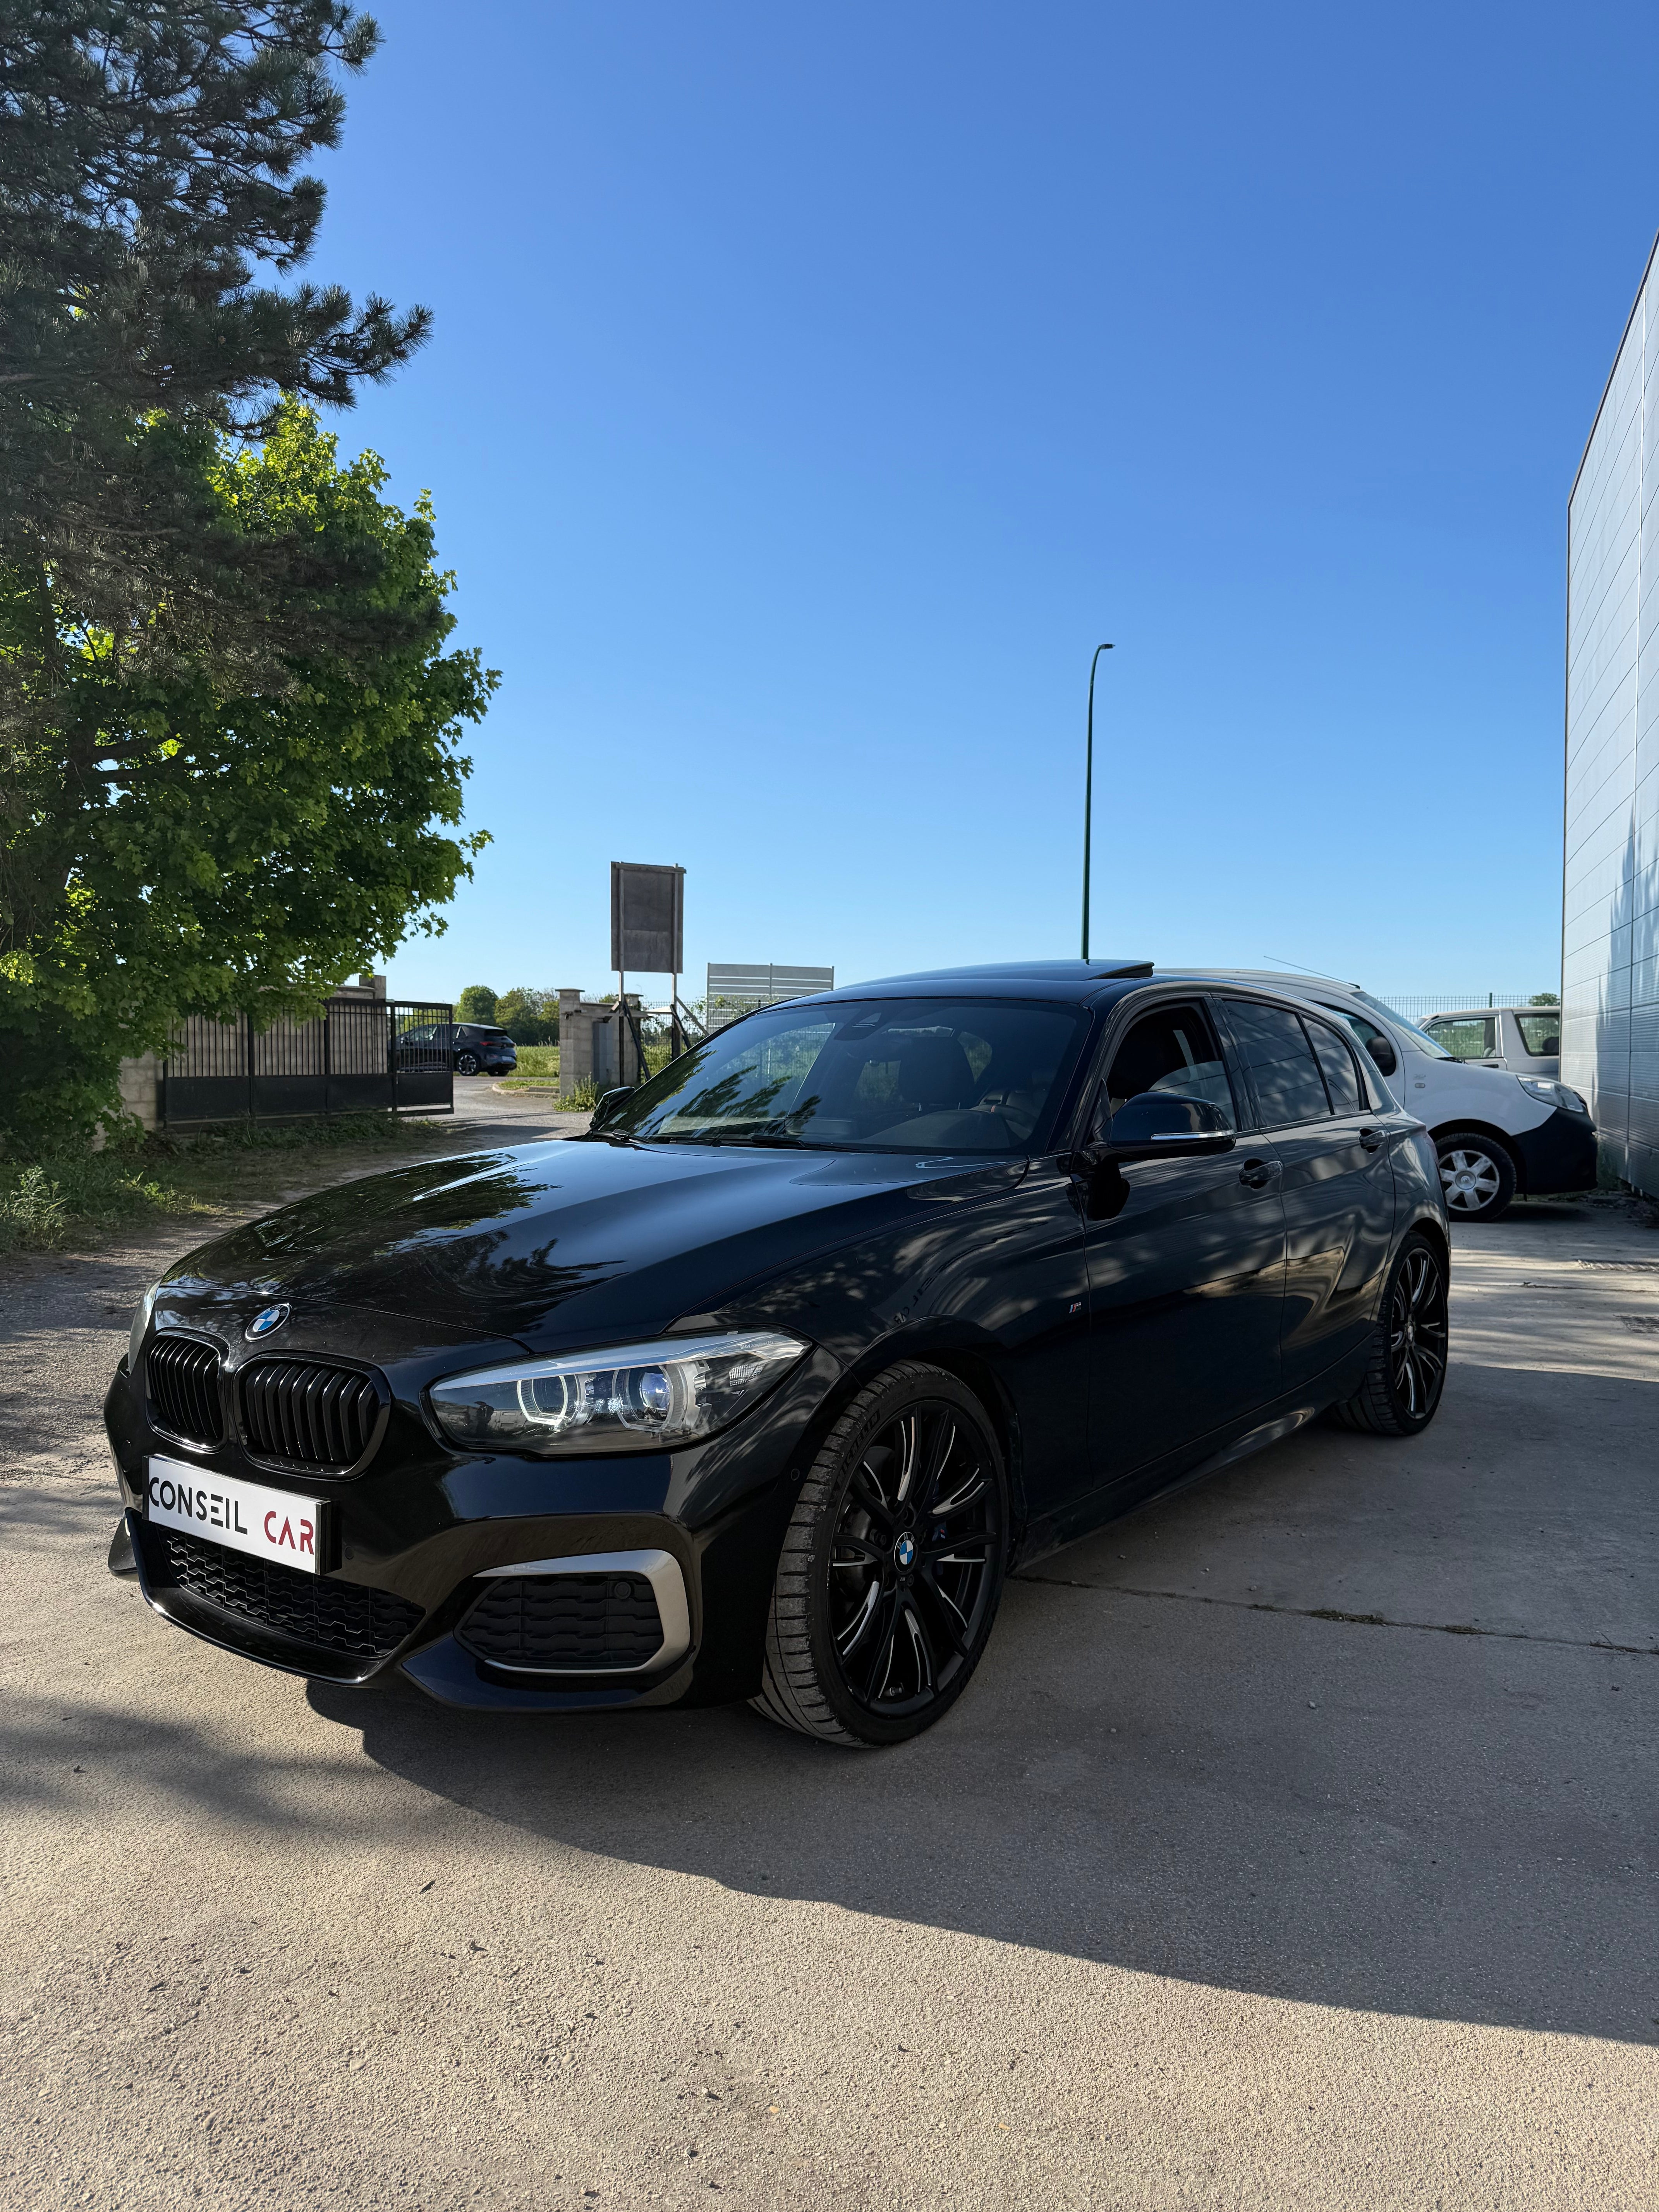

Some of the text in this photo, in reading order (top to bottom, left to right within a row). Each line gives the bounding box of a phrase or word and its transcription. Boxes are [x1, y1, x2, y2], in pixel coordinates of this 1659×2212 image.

[836, 1412, 878, 1487] MICHELIN
[149, 1477, 314, 1555] CONSEIL CAR
[897, 1533, 915, 1549] BMW
